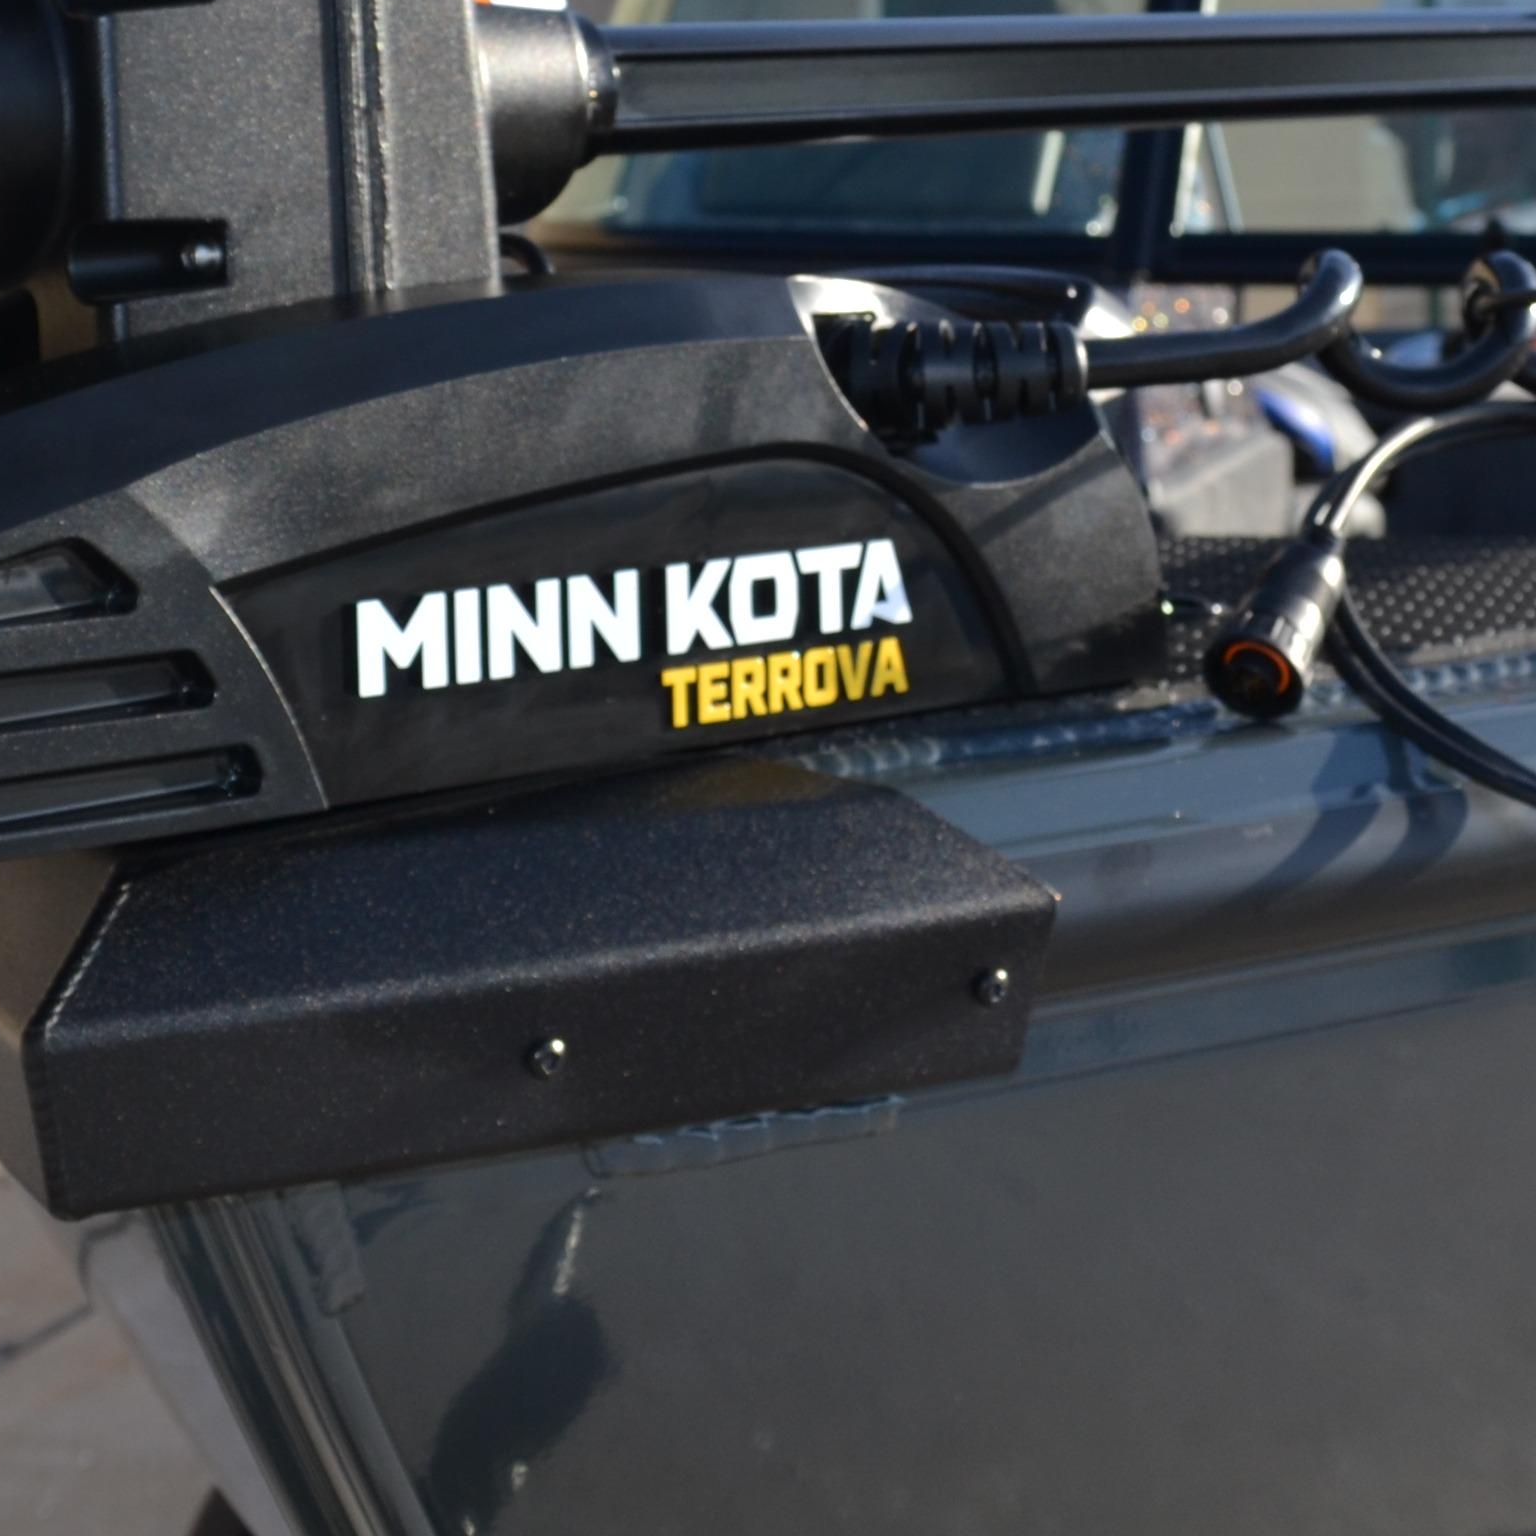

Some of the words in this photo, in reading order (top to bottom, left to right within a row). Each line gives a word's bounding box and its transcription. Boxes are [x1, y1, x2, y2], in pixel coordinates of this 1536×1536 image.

[355, 568, 642, 698] MINN
[664, 538, 914, 656] KOTA
[661, 636, 910, 729] TERROVA
